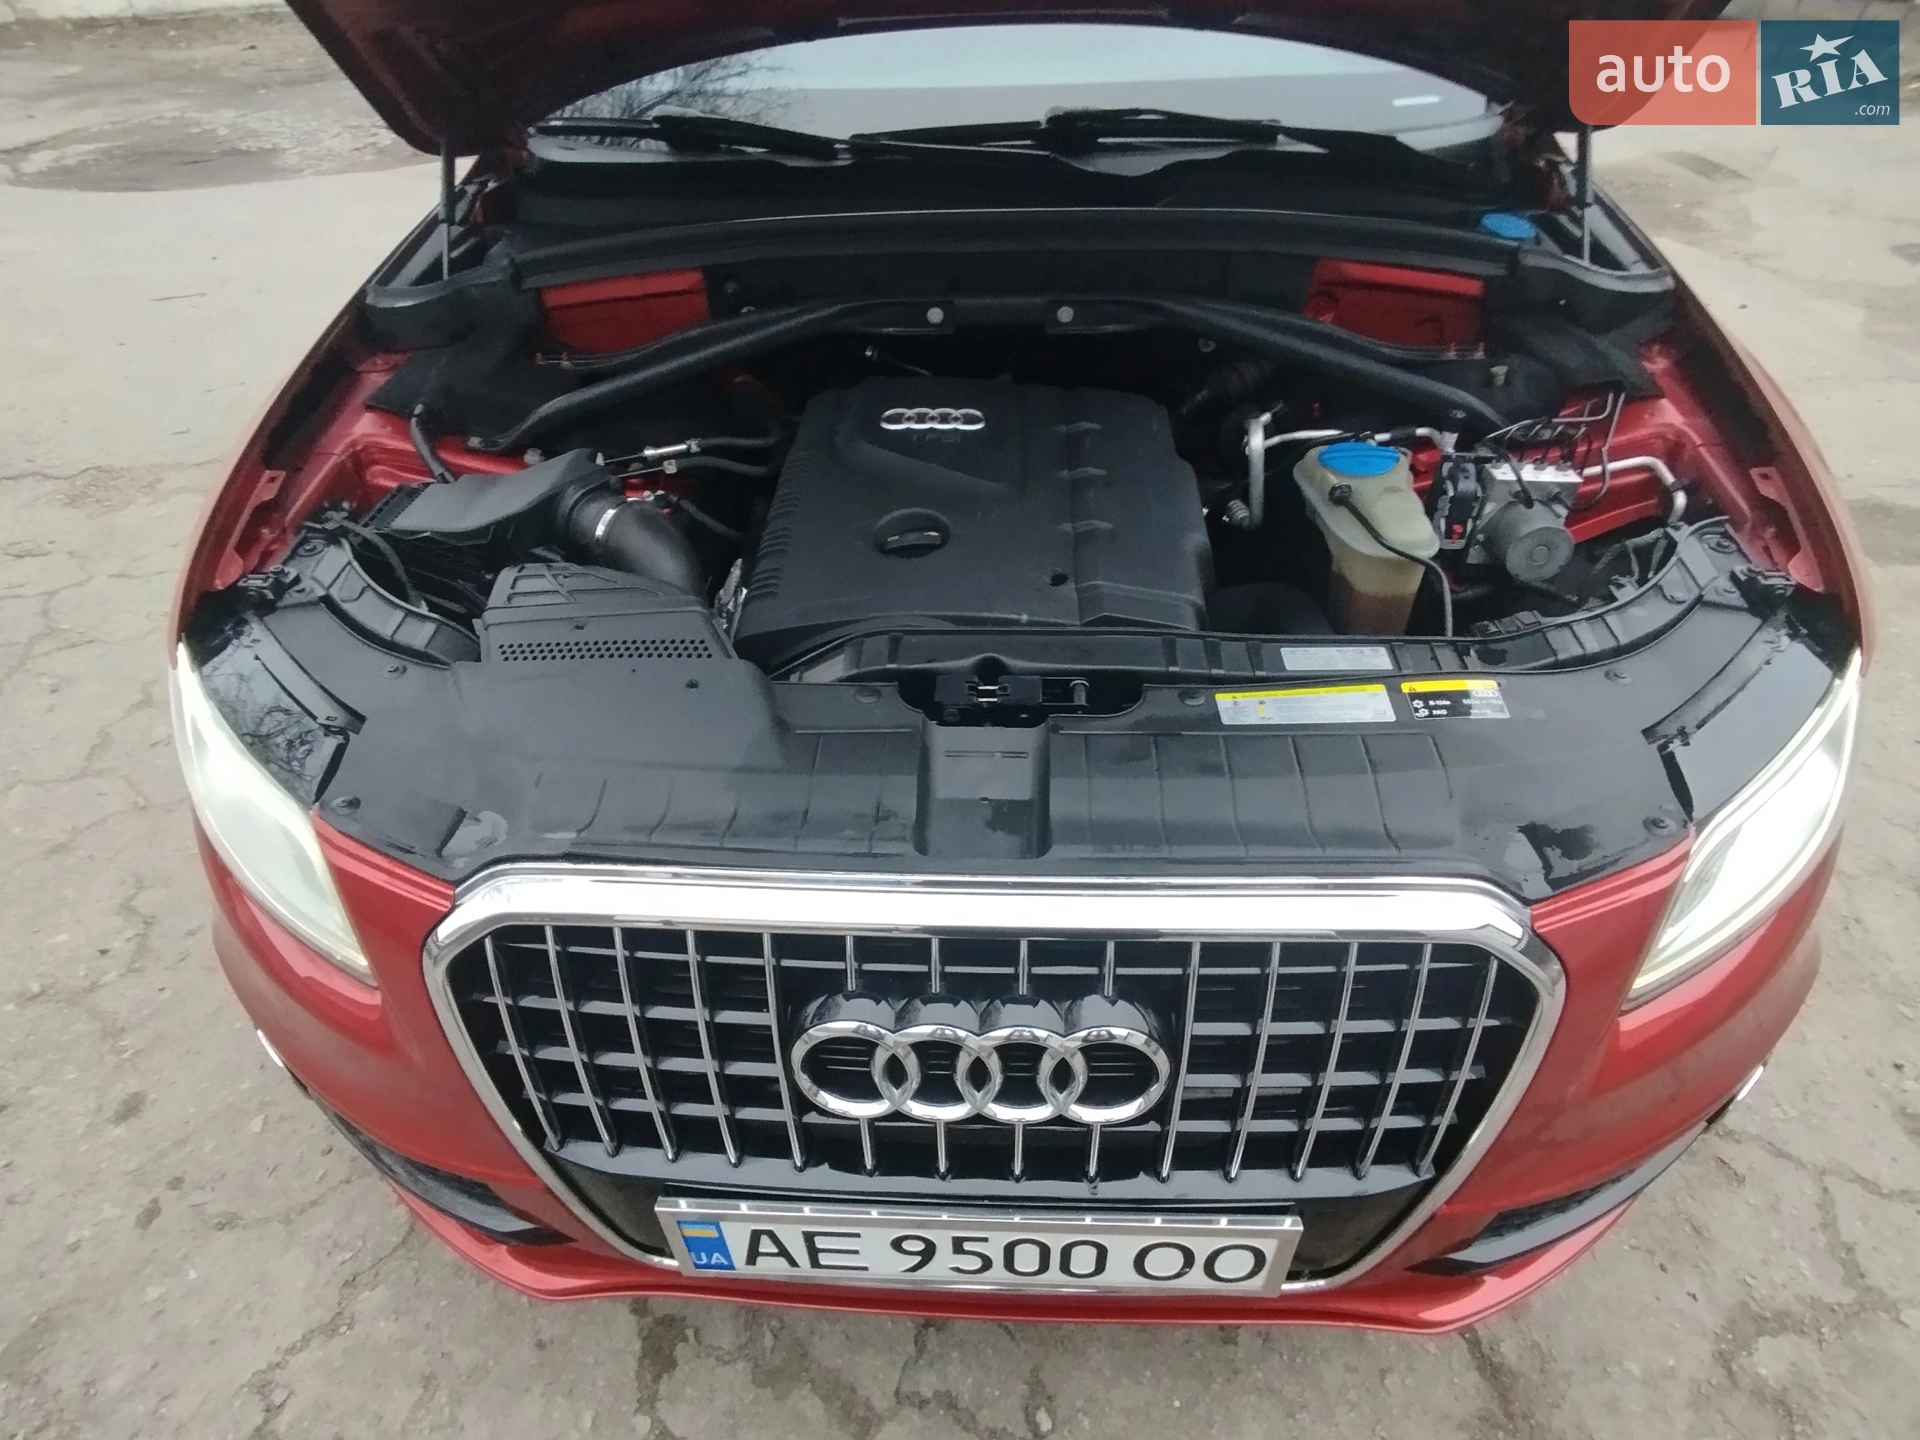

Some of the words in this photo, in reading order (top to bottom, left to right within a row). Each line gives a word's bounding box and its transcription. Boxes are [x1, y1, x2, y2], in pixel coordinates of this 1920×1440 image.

[691, 1252, 729, 1265] UA
[744, 1228, 869, 1271] AE
[890, 1234, 1108, 1279] 9500
[1133, 1241, 1267, 1283] OO
